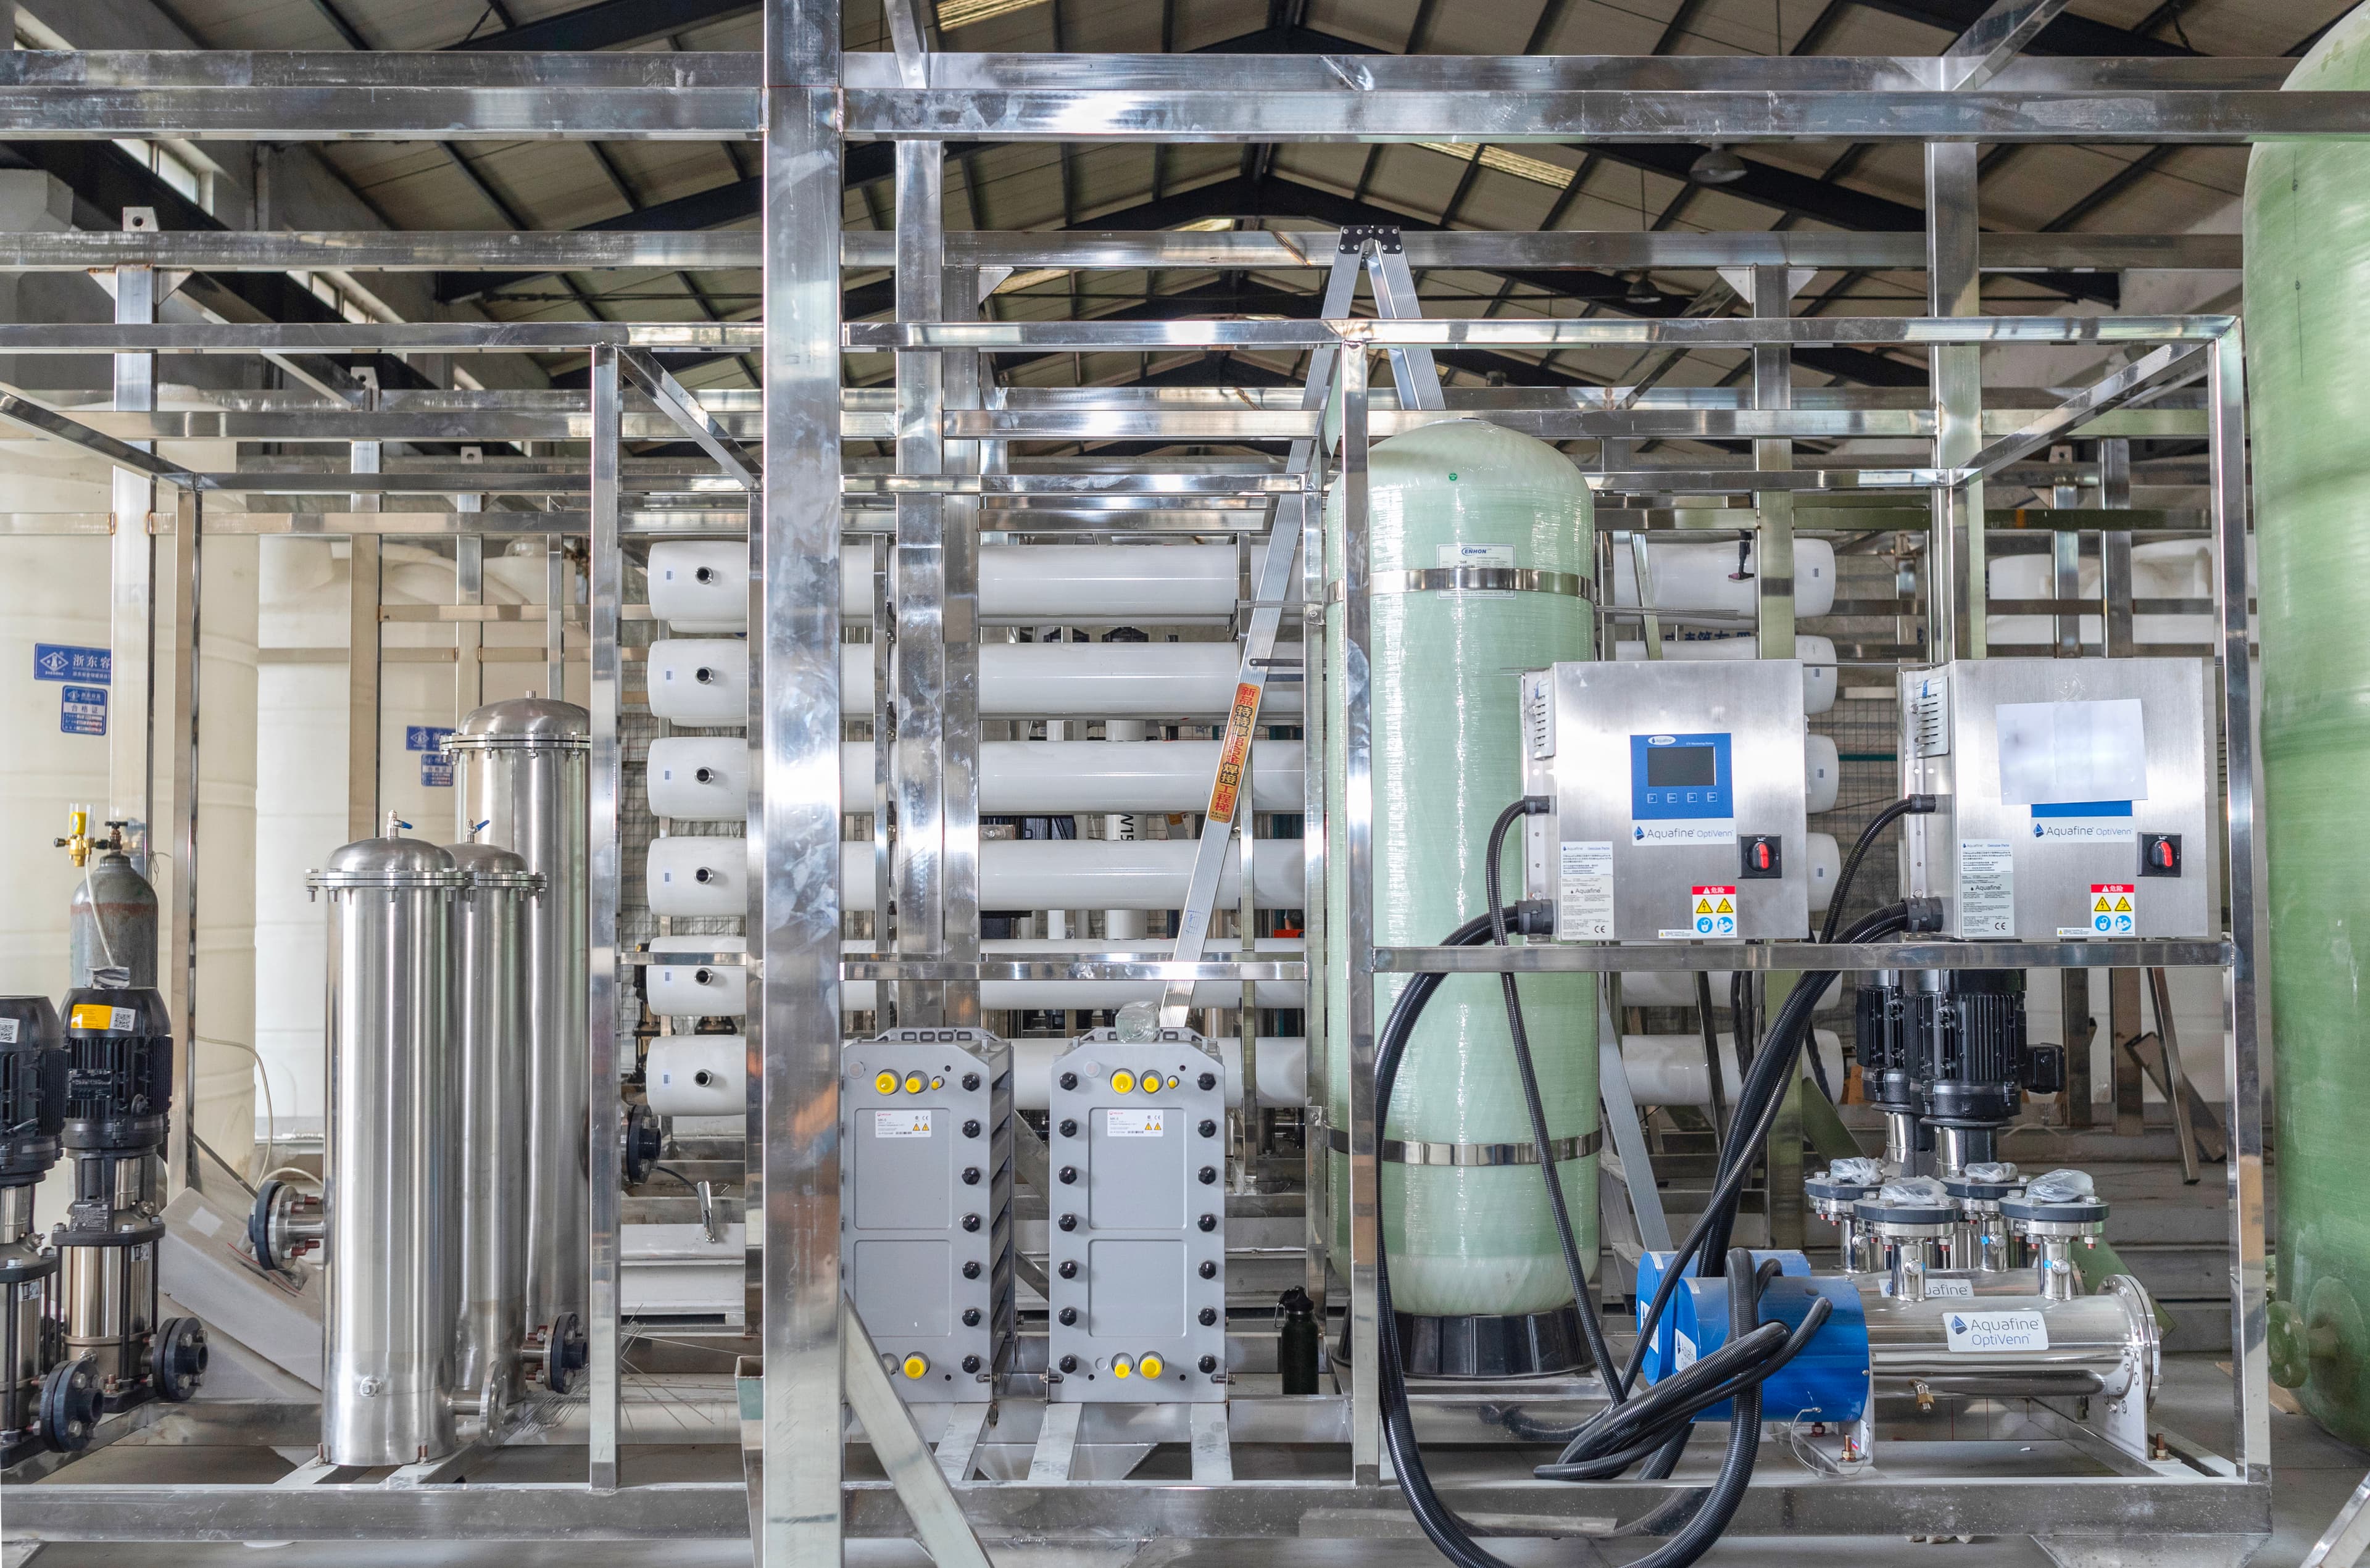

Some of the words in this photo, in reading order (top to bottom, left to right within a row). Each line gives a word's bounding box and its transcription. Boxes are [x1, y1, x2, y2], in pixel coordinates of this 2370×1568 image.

[1647, 828, 1695, 839] Aquafine
[1697, 829, 1733, 838] OptiVenn
[2046, 826, 2094, 837] Aquafine
[2096, 828, 2132, 836] OptiVenn
[2110, 884, 2124, 892] 危险
[1594, 925, 1605, 933] CE
[1995, 922, 2006, 930] CE
[1971, 1318, 2039, 1334] Aquafine
[1971, 1334, 2031, 1347] OptiVenn
